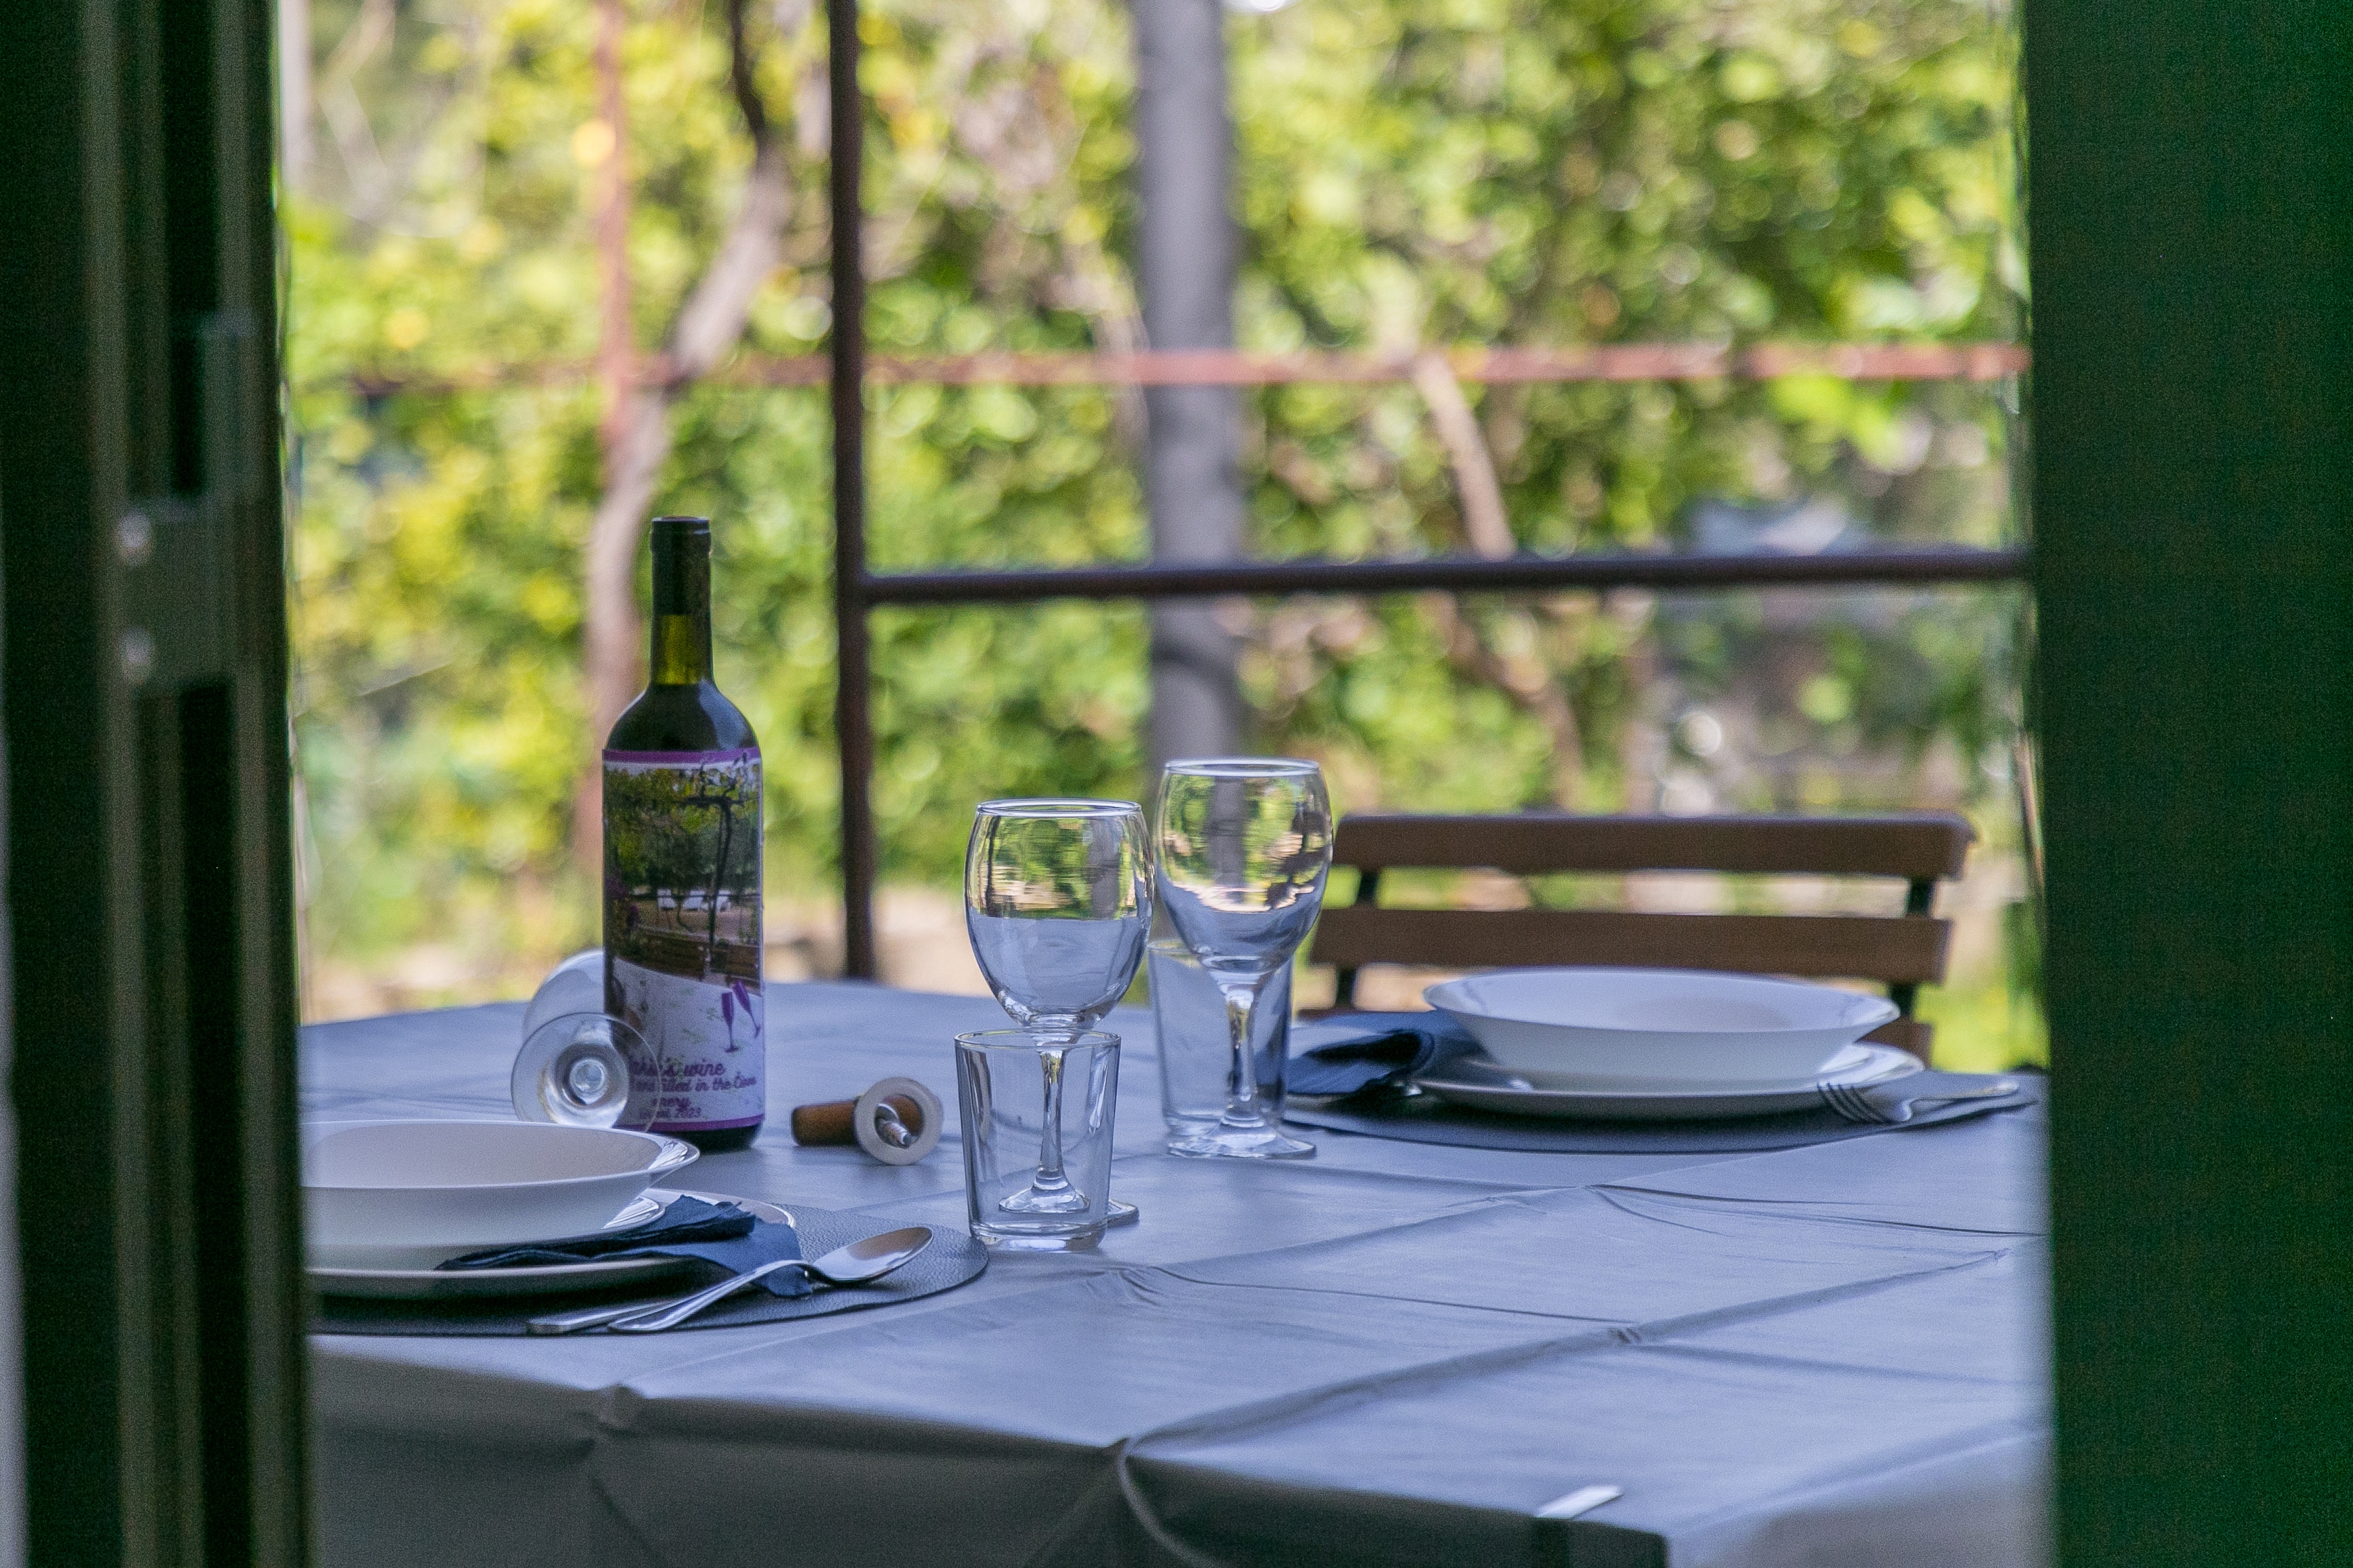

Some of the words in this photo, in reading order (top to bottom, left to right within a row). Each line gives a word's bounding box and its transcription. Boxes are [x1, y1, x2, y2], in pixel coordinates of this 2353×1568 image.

[683, 1058, 726, 1076] wine
[657, 1078, 692, 1092] illed
[695, 1078, 709, 1092] in
[712, 1077, 731, 1091] the
